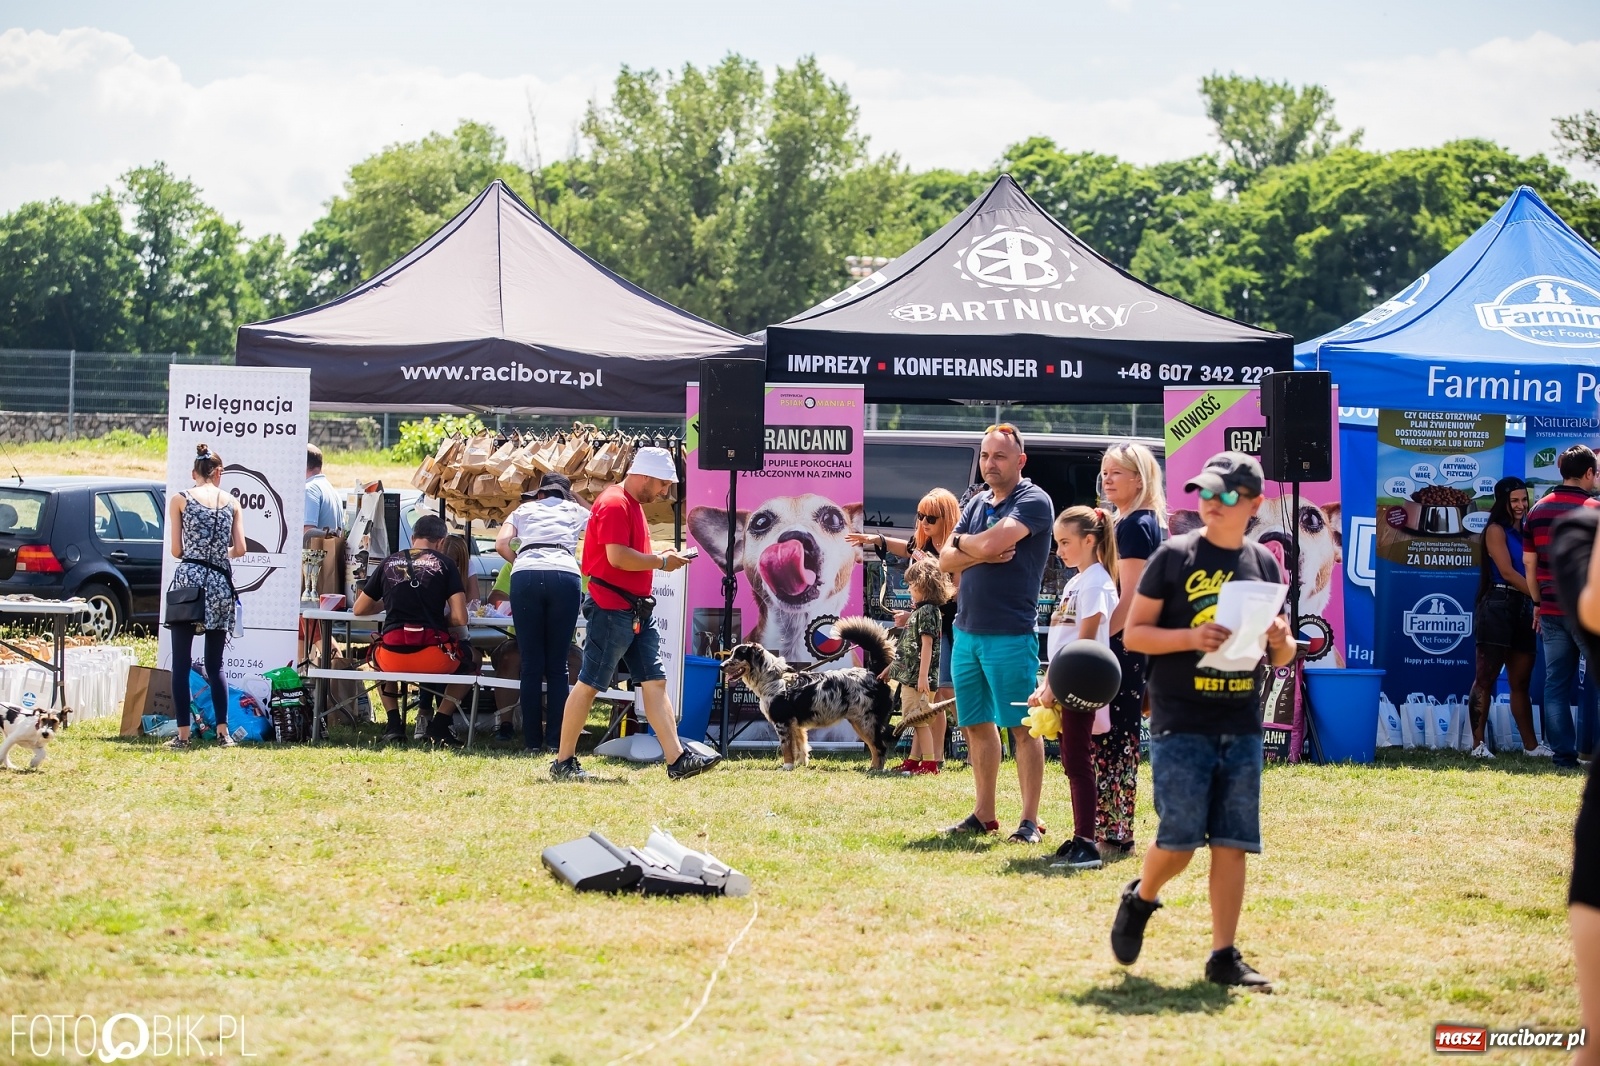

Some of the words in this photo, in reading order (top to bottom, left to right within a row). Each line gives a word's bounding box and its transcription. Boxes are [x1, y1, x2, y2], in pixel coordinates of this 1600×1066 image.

[888, 298, 1158, 331] BARTNICKY
[1530, 329, 1555, 337] Pet
[788, 354, 871, 374] IMPREZY
[893, 357, 1038, 378] KONFERANSJER
[1060, 360, 1083, 378] DJ
[1117, 363, 1151, 380] +48
[1159, 365, 1193, 381] 607
[1200, 366, 1234, 382] 342
[400, 361, 603, 389] www.raciborz.pl
[1427, 365, 1562, 403] Farmina
[185, 393, 293, 416] Pielęgnacja
[1170, 393, 1221, 441] NOWOŚĆ
[1404, 411, 1417, 419] CZY
[1418, 411, 1443, 420] CHCESZ
[179, 416, 258, 438] Twojego
[263, 422, 297, 438] psa
[1410, 420, 1428, 428] PLAN
[765, 428, 847, 450] RANCANN
[1395, 429, 1447, 438] DOSTOSOWANY
[1448, 429, 1457, 438] DO
[1459, 430, 1490, 439] POTRZEB
[1399, 438, 1432, 446] TWOJEGO
[1433, 439, 1447, 447] PSA
[1448, 439, 1462, 447] LUB
[1463, 440, 1485, 448] KOTA?
[768, 460, 799, 468] PUPILE
[800, 460, 852, 468] POKOCHALI
[1443, 462, 1477, 470] AKTYWNOŚĆ
[1415, 472, 1431, 480] WAGĘ
[1392, 487, 1406, 495] RASĘ
[242, 555, 255, 563] DLA
[257, 556, 271, 564] PSA
[1407, 554, 1420, 565] ZA
[1424, 554, 1472, 566] DARMO!!!
[652, 584, 675, 597] awodów
[1410, 616, 1465, 631] Farmina
[1433, 636, 1452, 644] Foods
[227, 658, 245, 667] 802
[247, 659, 264, 669] 546
[1404, 657, 1423, 665] Happy
[1436, 658, 1455, 666] Happy
[1194, 676, 1226, 691] WEST
[1067, 692, 1104, 709] FITNESS
